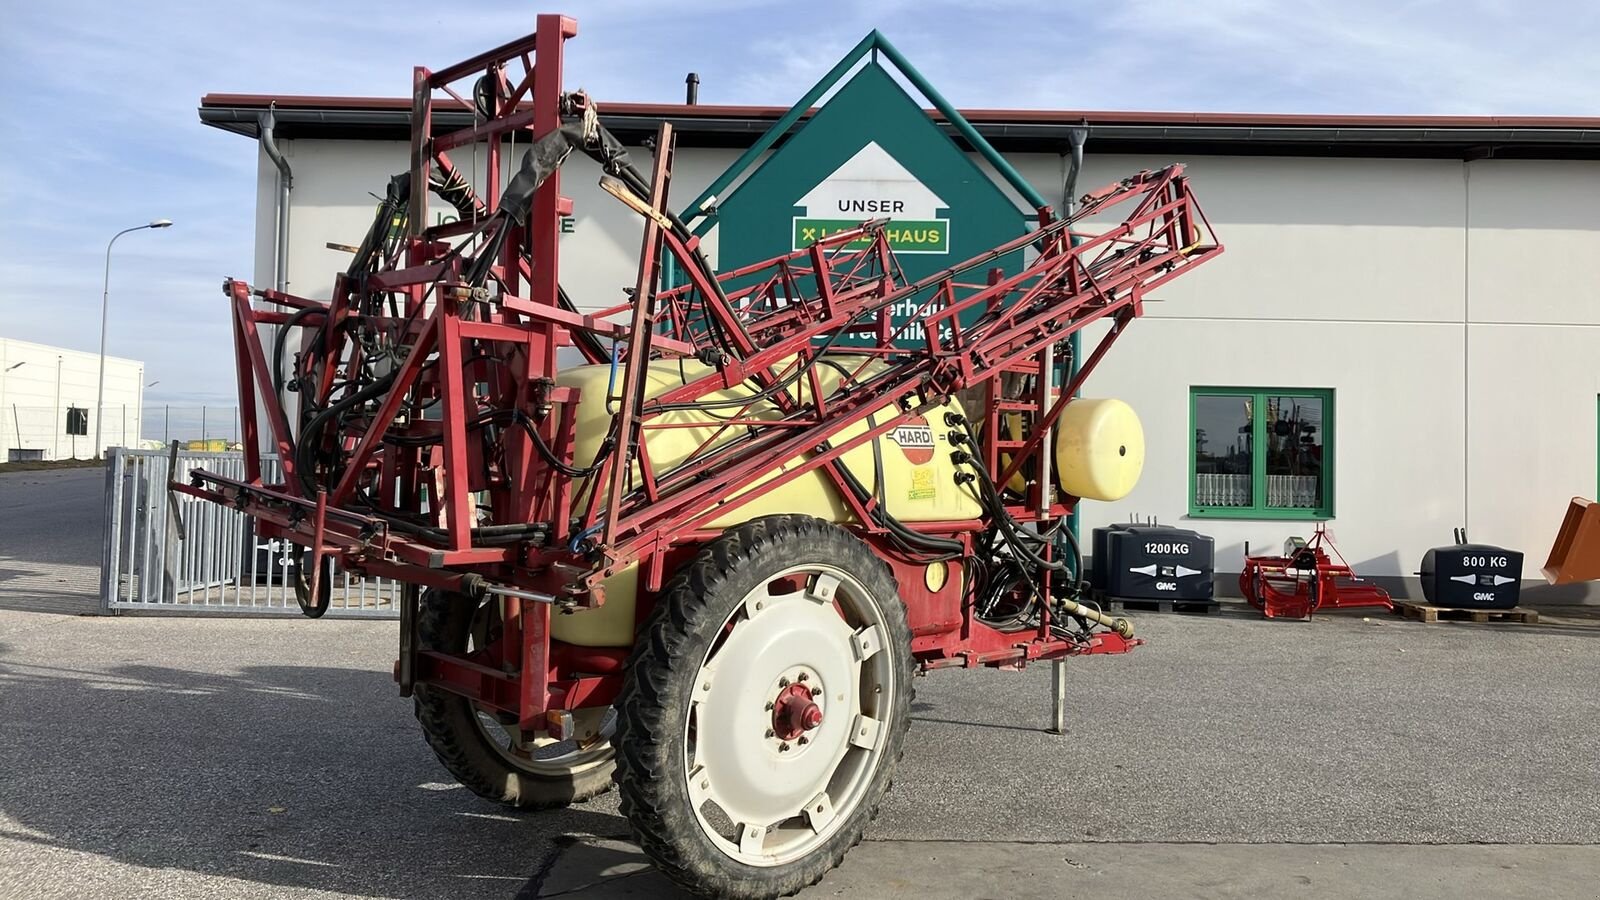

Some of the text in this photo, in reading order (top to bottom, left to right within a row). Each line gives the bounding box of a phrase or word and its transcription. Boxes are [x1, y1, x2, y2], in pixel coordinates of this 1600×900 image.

[838, 200, 904, 213] UNSER
[1144, 543, 1189, 554] 1200 KG
[1463, 556, 1507, 567] 800 KG
[1155, 582, 1177, 591] GMC
[1473, 592, 1495, 601] GMC
